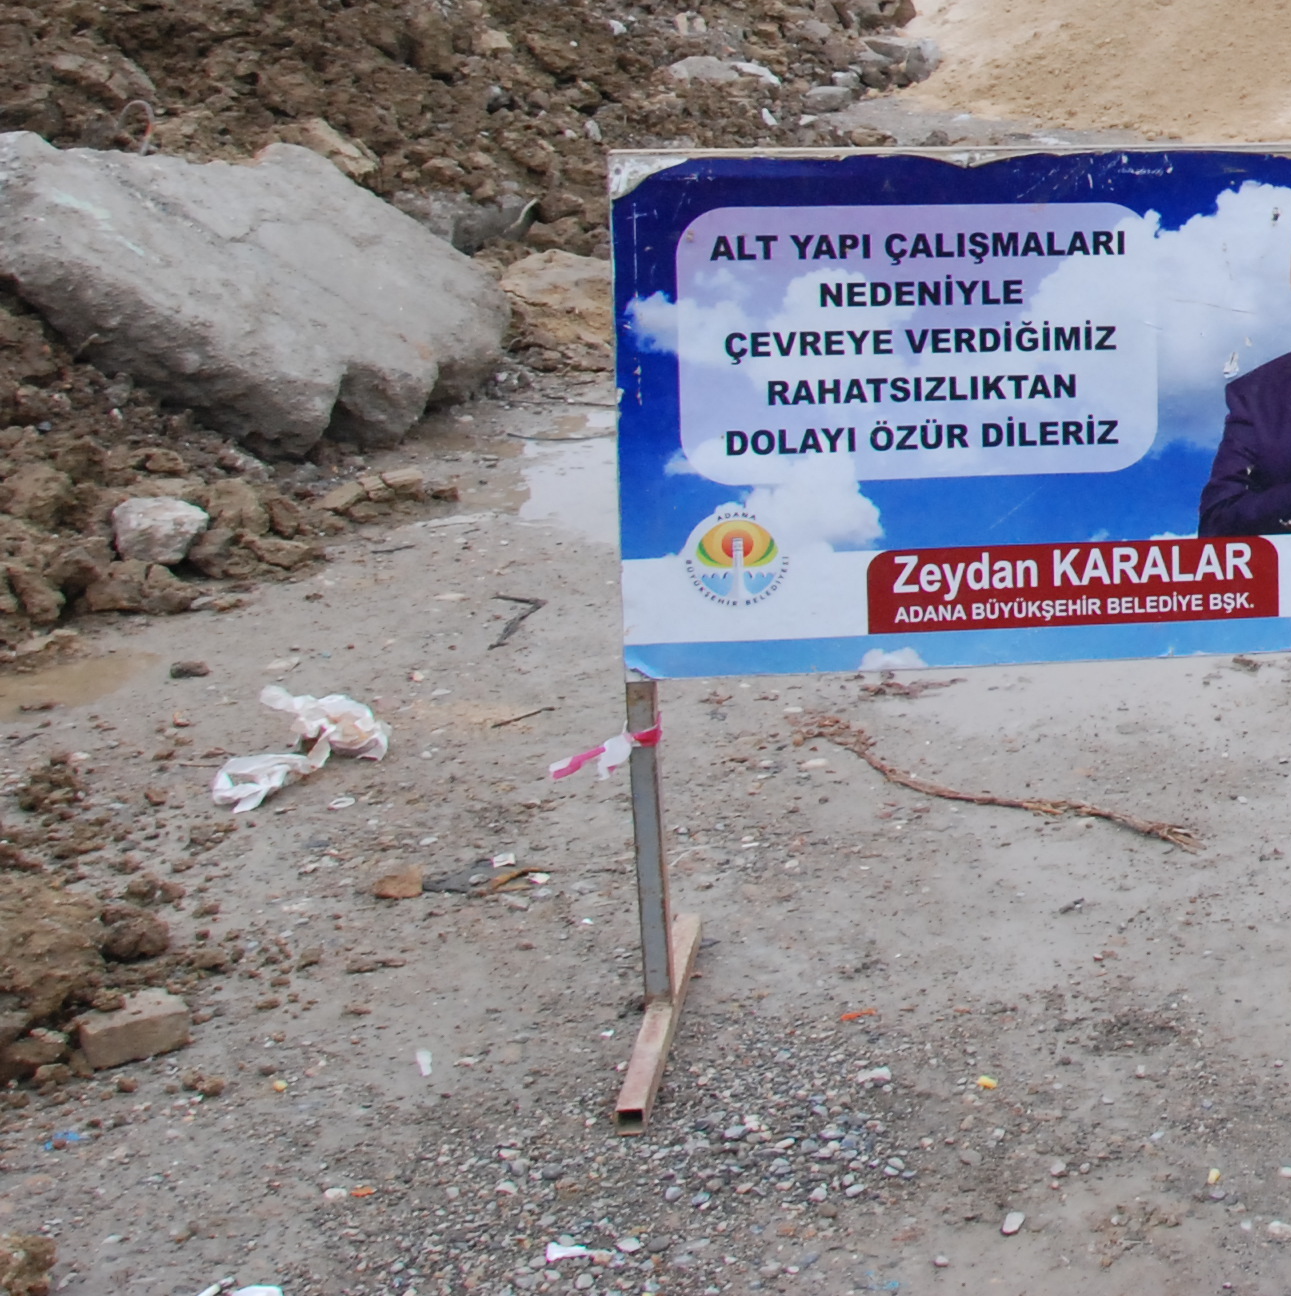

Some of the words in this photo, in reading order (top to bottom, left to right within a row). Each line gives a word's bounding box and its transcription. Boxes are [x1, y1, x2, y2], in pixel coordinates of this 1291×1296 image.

[710, 235, 778, 261] ALT
[790, 234, 871, 260] YAPI
[884, 231, 1126, 265] ÇALIŞMALARI
[820, 274, 1024, 307] NEDENİYLE
[724, 330, 893, 365] ÇEVREYE
[905, 320, 1117, 354] VERDİĞİMİZ
[768, 374, 1077, 406] RAHATSIZLIKTAN
[726, 427, 857, 456] DOLAYI
[869, 419, 970, 452] ÖZÜR
[982, 414, 1119, 448] DİLERİZ
[717, 511, 757, 522] ADANA
[893, 552, 1040, 601] Zeydan
[1053, 541, 1254, 588] KARALAR
[894, 605, 967, 624] ADANA
[972, 594, 1102, 622] BÜYÜKŞEHİR
[1108, 591, 1203, 615] BELEDİYE
[1209, 592, 1255, 613] BŞK.
